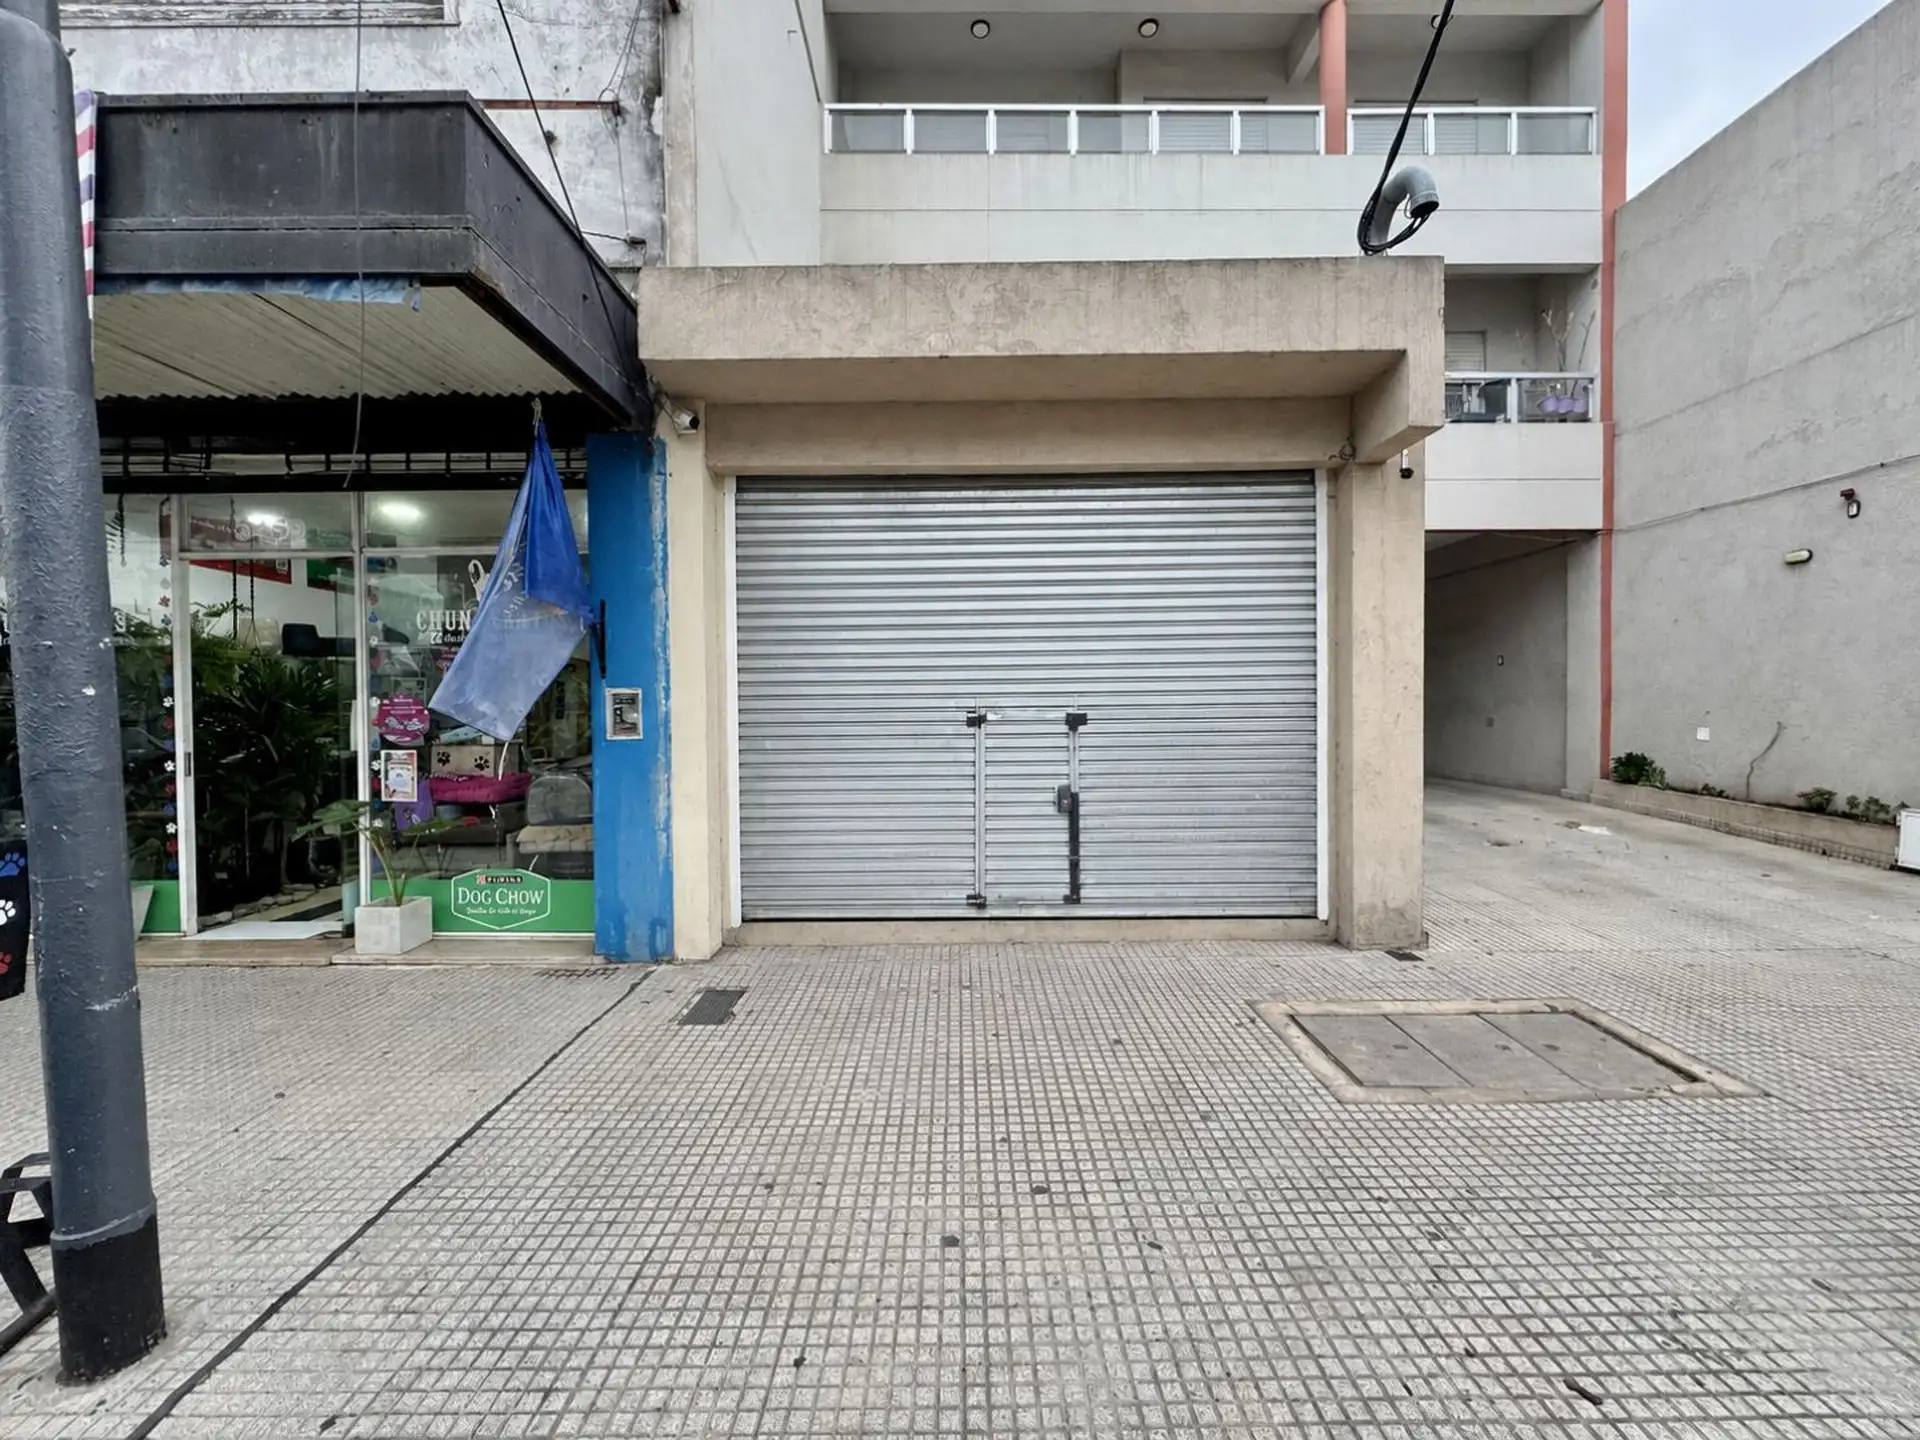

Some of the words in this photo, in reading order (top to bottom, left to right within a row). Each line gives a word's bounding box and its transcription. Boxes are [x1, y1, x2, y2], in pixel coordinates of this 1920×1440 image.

[416, 609, 472, 631] CHUN
[458, 887, 492, 905] DOG
[495, 887, 545, 905] CHOW
